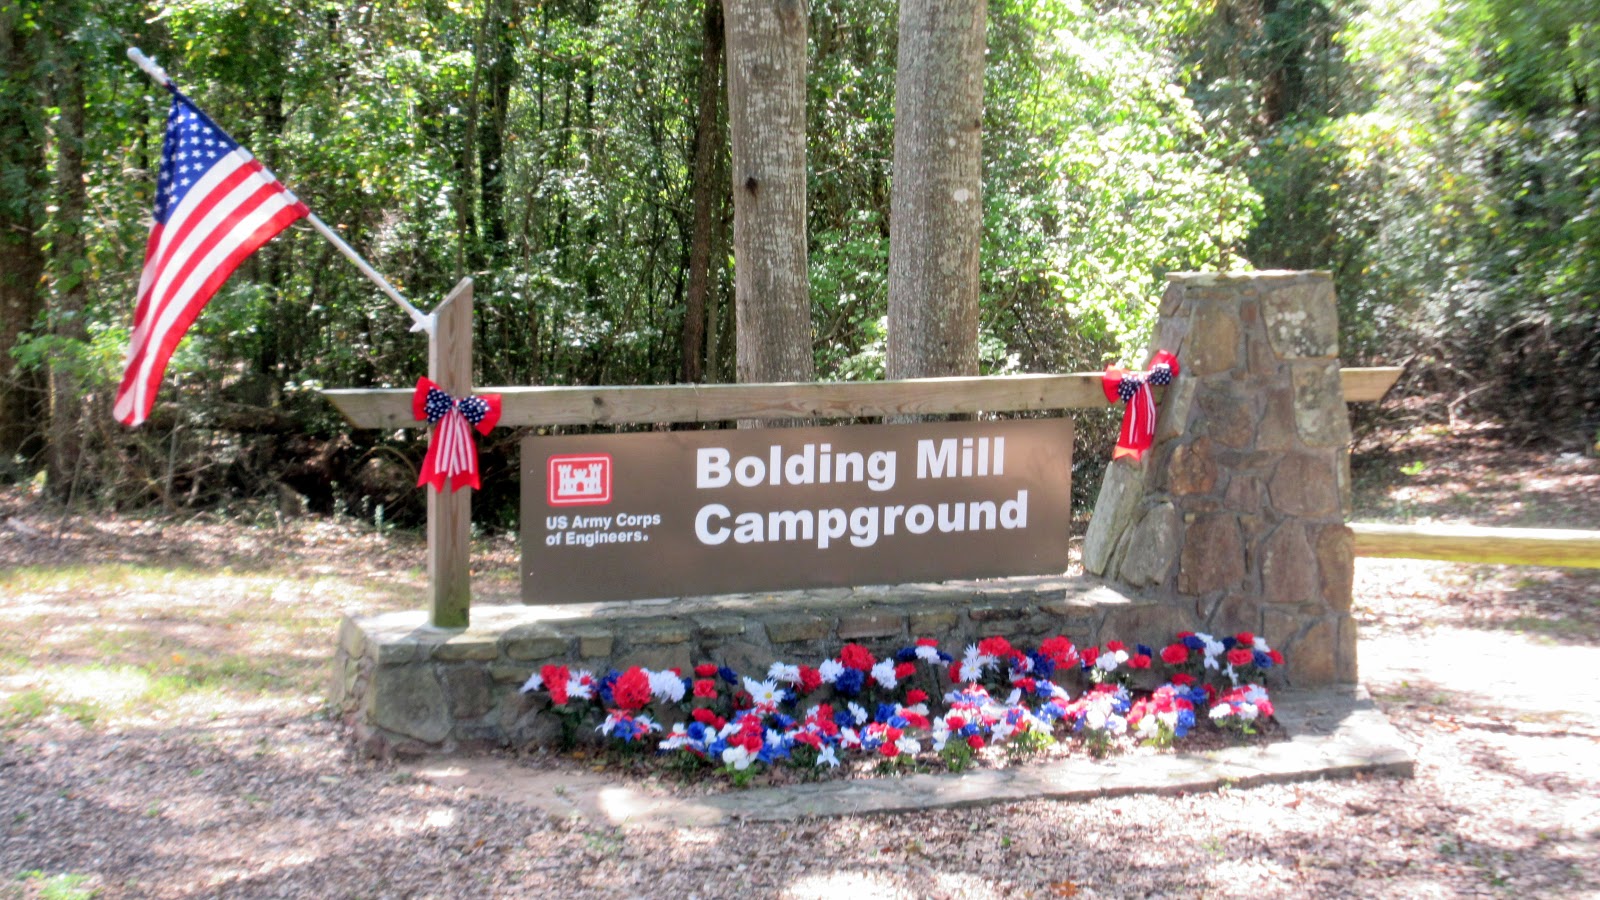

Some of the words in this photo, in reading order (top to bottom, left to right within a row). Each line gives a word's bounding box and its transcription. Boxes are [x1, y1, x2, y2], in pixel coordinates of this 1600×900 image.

[696, 443, 897, 492] Bolding
[916, 436, 1005, 479] Mill
[545, 515, 568, 530] US
[571, 515, 612, 531] Army
[615, 512, 661, 529] Corps
[694, 489, 1028, 549] Campground
[545, 531, 562, 546] of
